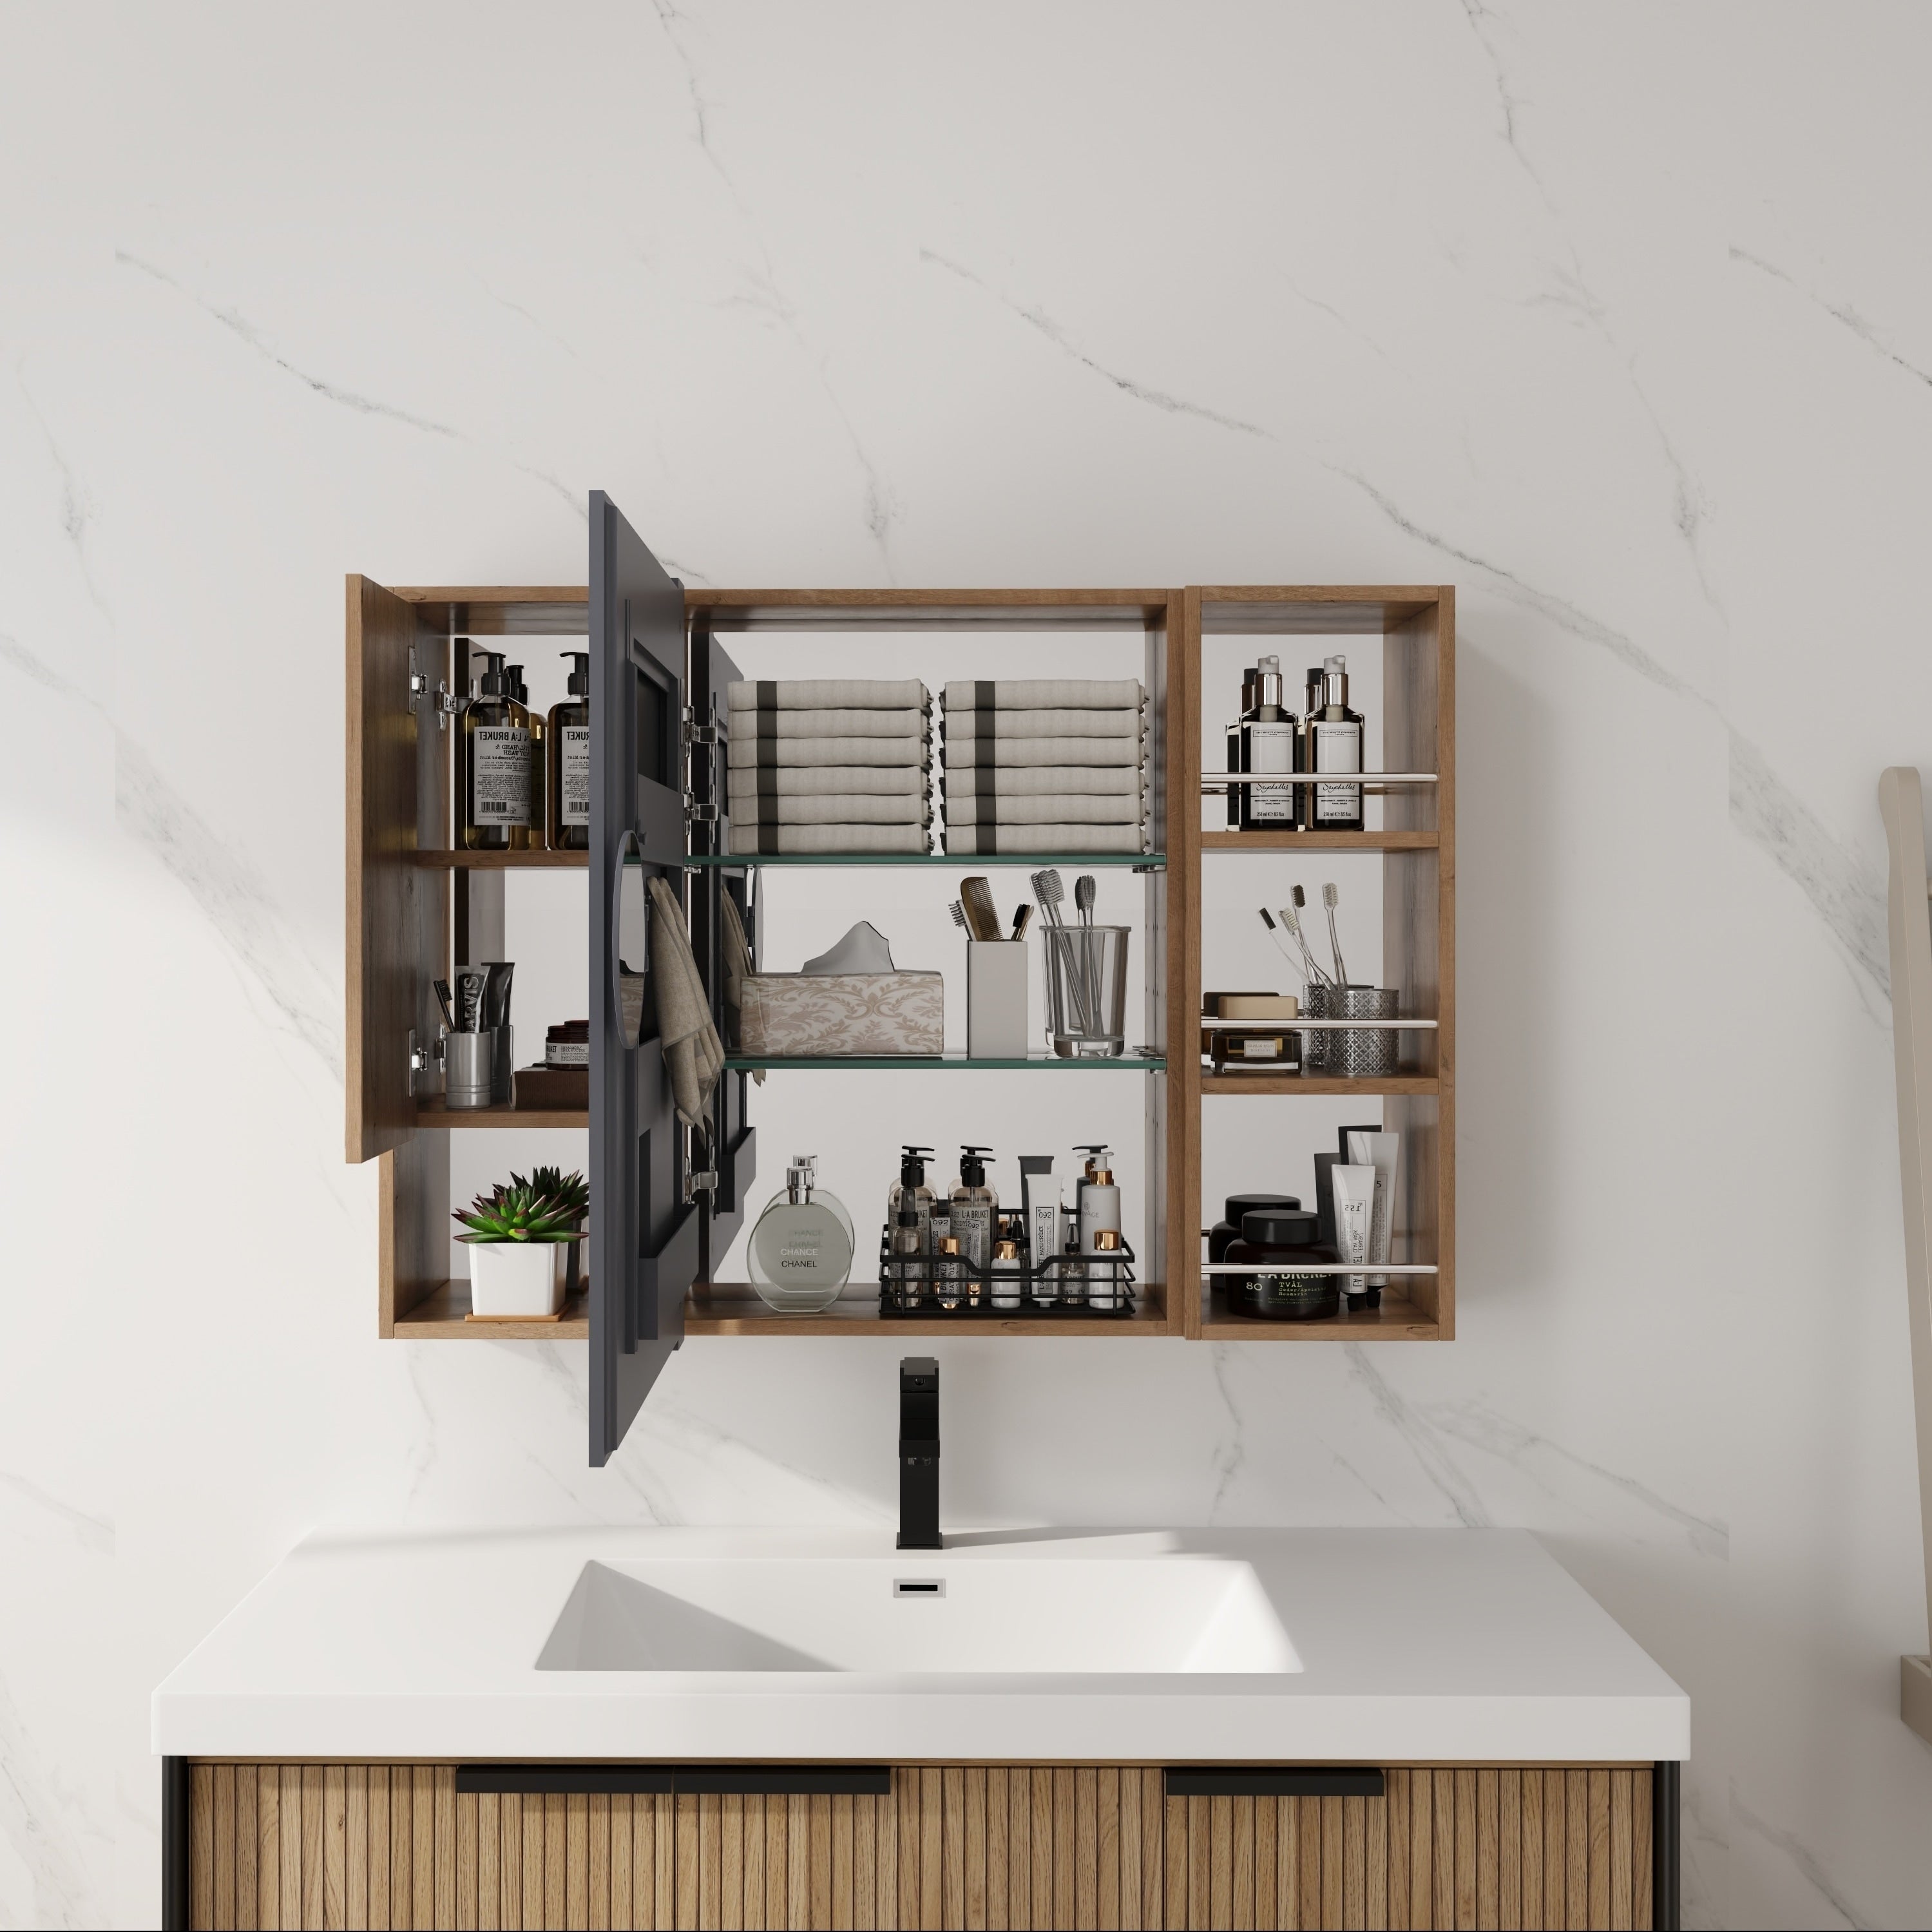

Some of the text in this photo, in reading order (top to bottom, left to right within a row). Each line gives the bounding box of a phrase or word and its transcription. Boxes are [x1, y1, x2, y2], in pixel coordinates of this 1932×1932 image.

[464, 977, 479, 1032] ARVIS
[971, 1210, 989, 1218] BRUKET
[1246, 1282, 1263, 1291] 80
